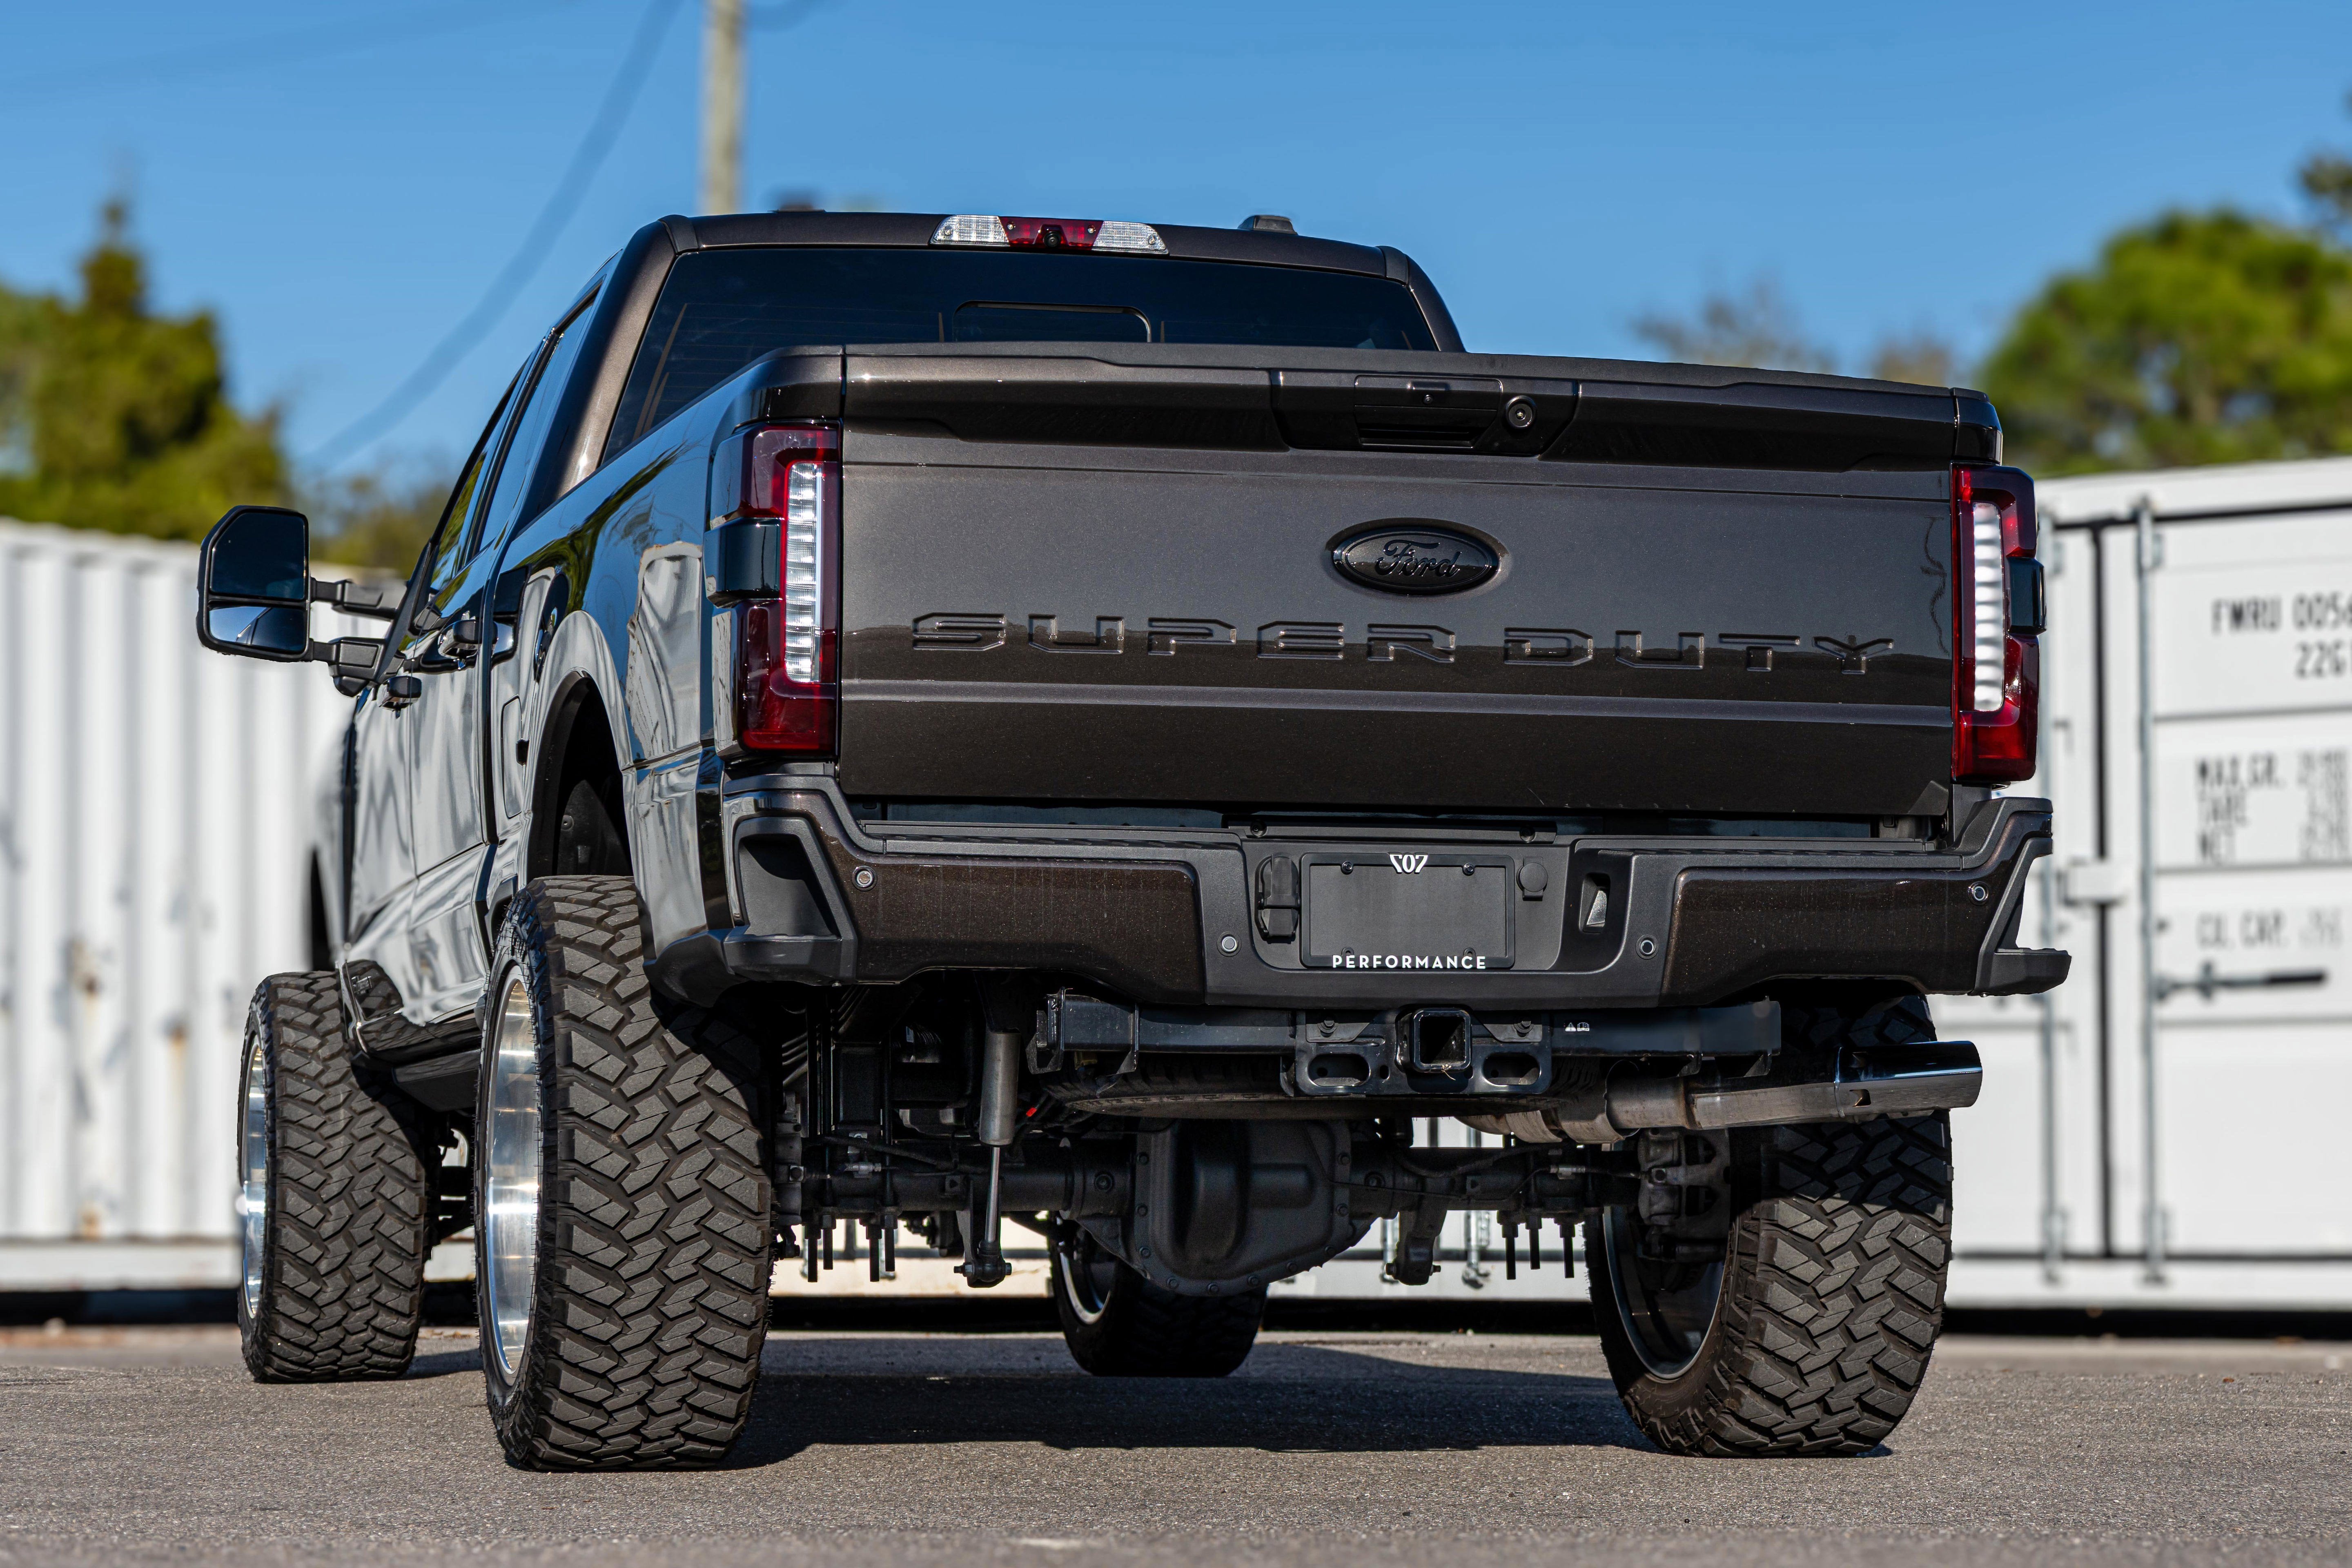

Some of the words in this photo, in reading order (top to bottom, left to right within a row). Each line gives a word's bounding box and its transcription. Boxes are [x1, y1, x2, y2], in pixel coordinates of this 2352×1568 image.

[1374, 539, 1463, 577] Ford
[911, 612, 1456, 664] SUPER
[1503, 626, 1895, 675] DUTY
[2295, 641, 2352, 677] 22G
[1332, 954, 1486, 969] PERFORMANCE
